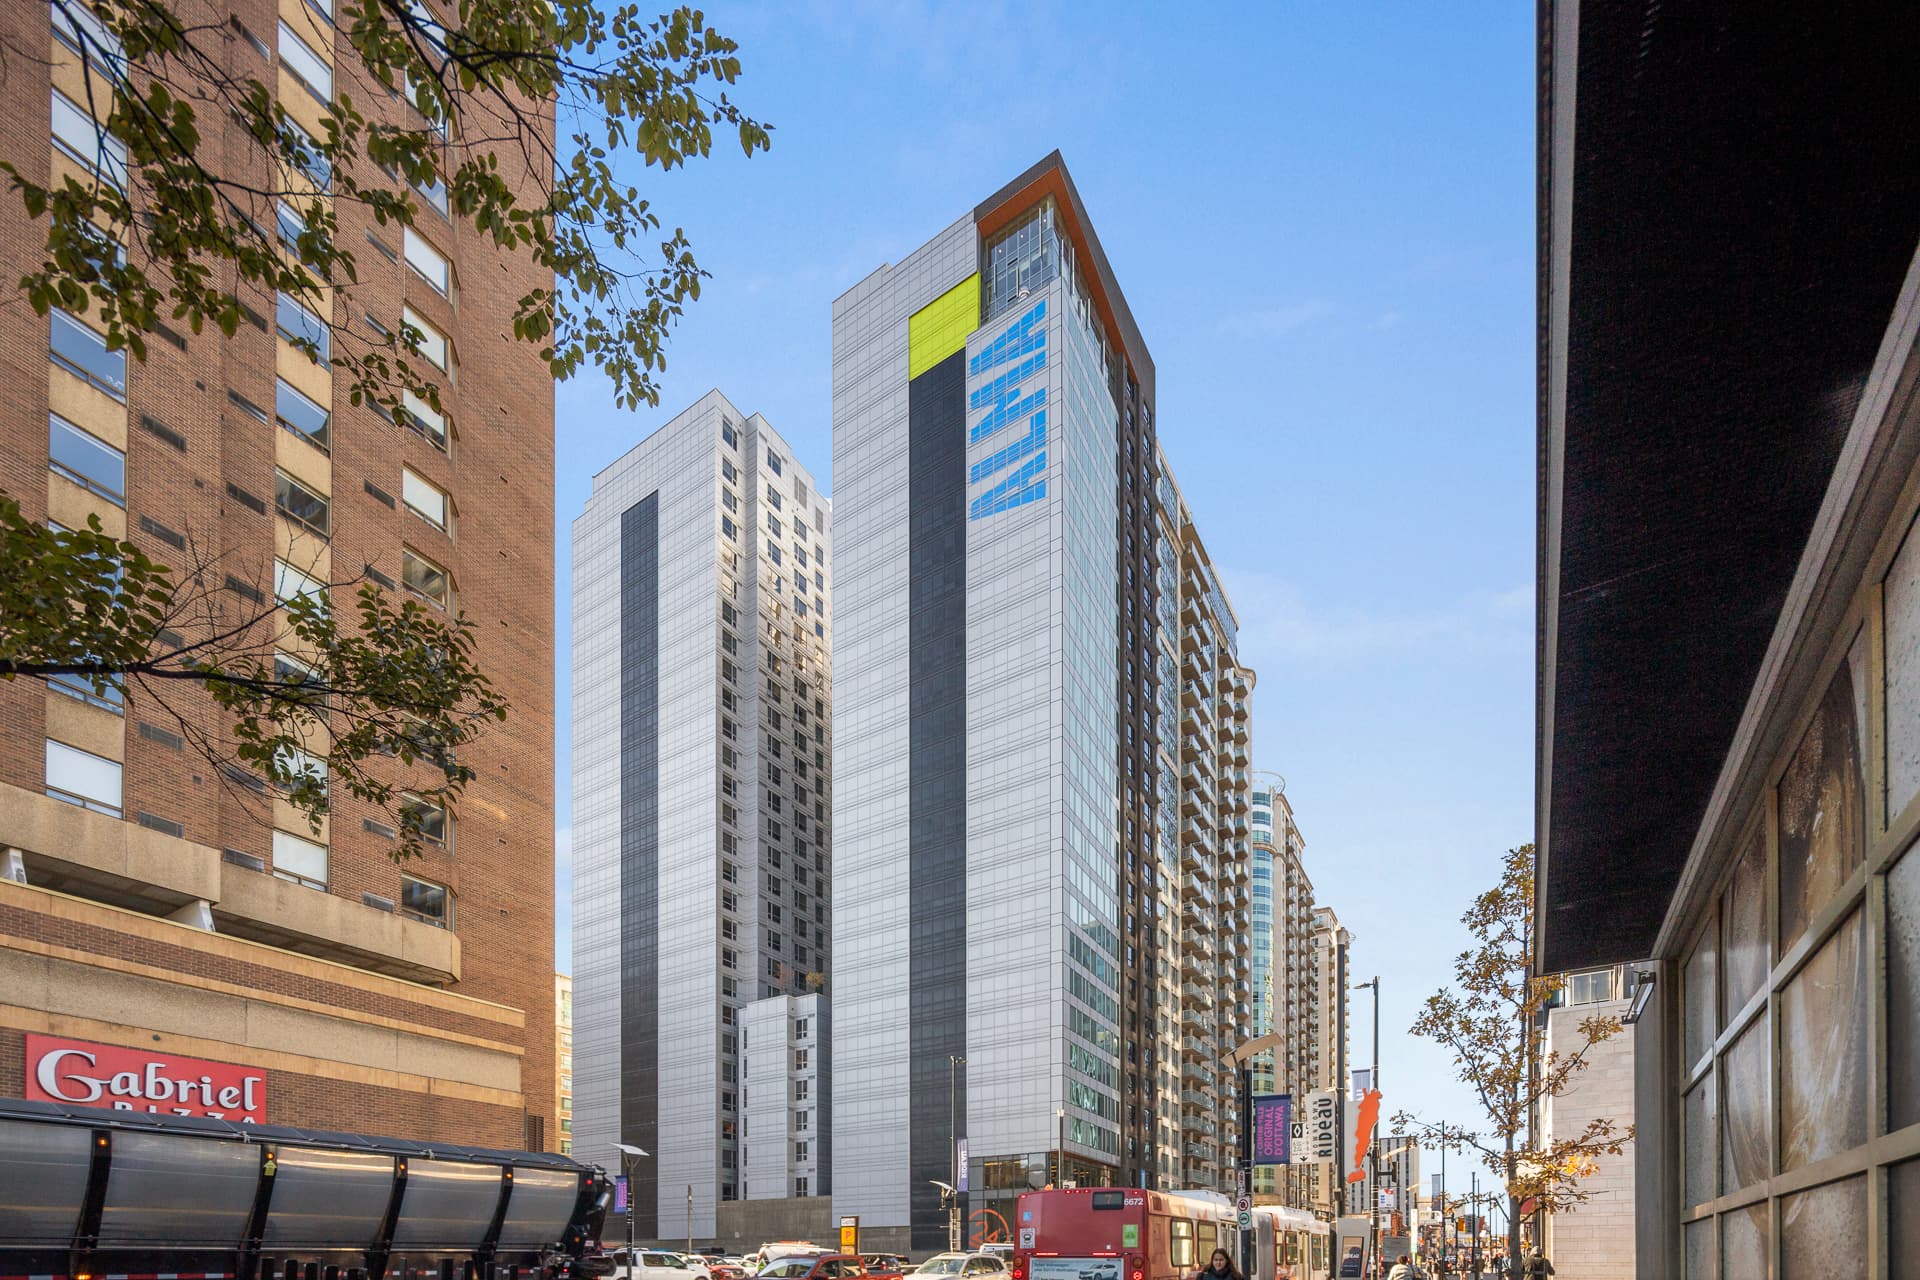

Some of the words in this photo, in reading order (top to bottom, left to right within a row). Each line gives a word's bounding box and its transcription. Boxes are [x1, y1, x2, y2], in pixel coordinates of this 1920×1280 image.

[969, 299, 1047, 522] ALMA
[37, 1049, 262, 1111] Gabriel
[1264, 1105, 1274, 1156] ORIGINAL
[1123, 1197, 1144, 1206] 6672
[845, 1230, 852, 1240] P
